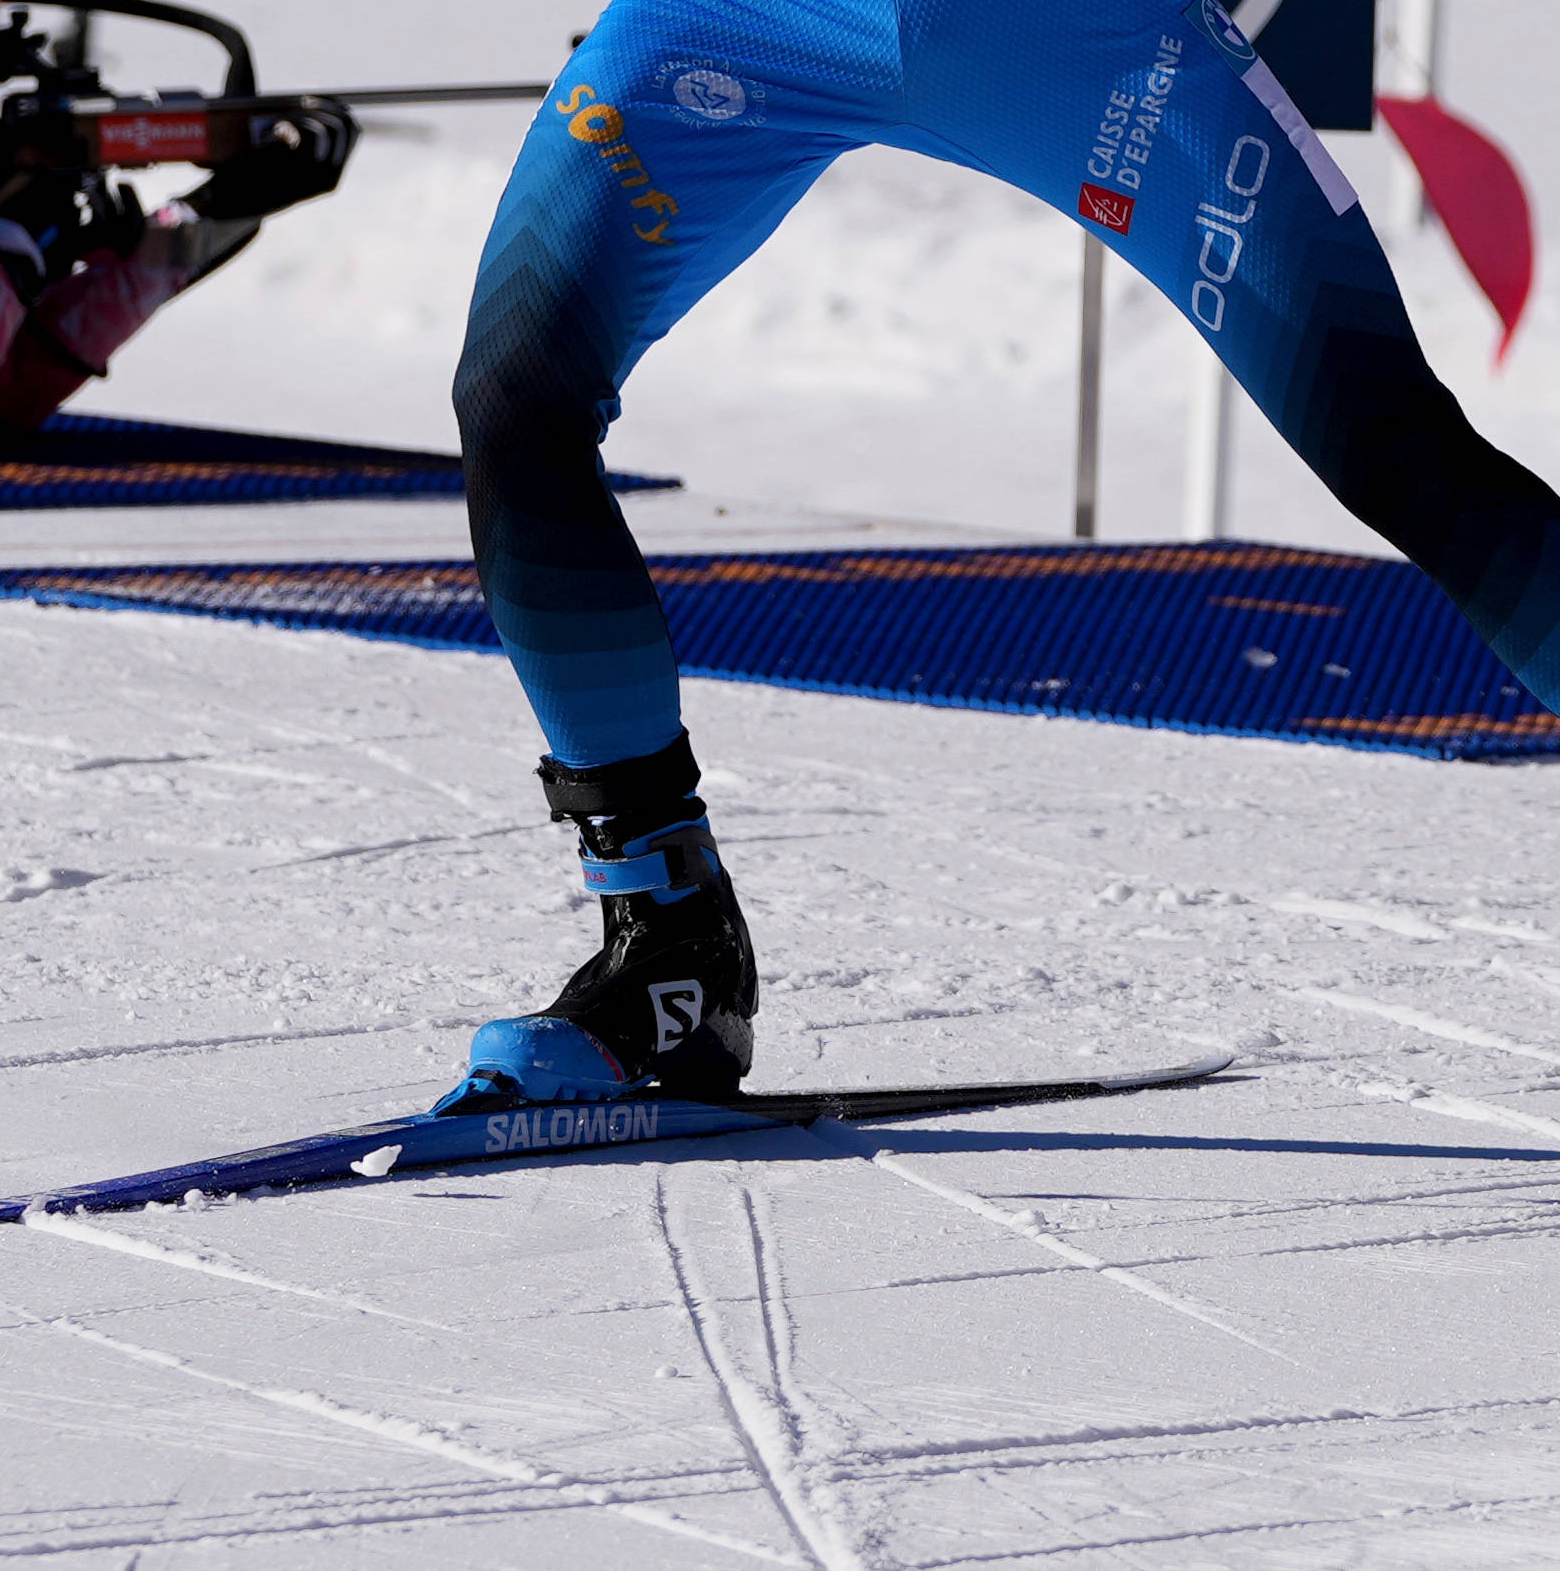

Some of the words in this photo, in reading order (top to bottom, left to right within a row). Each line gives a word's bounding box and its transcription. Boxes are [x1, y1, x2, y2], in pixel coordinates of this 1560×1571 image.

[556, 84, 680, 246] somfy
[1087, 90, 1135, 179] CAISSE
[1117, 34, 1183, 190] D'EPARGNE
[1191, 134, 1271, 333] odlo
[485, 1105, 659, 1153] SALOMON
